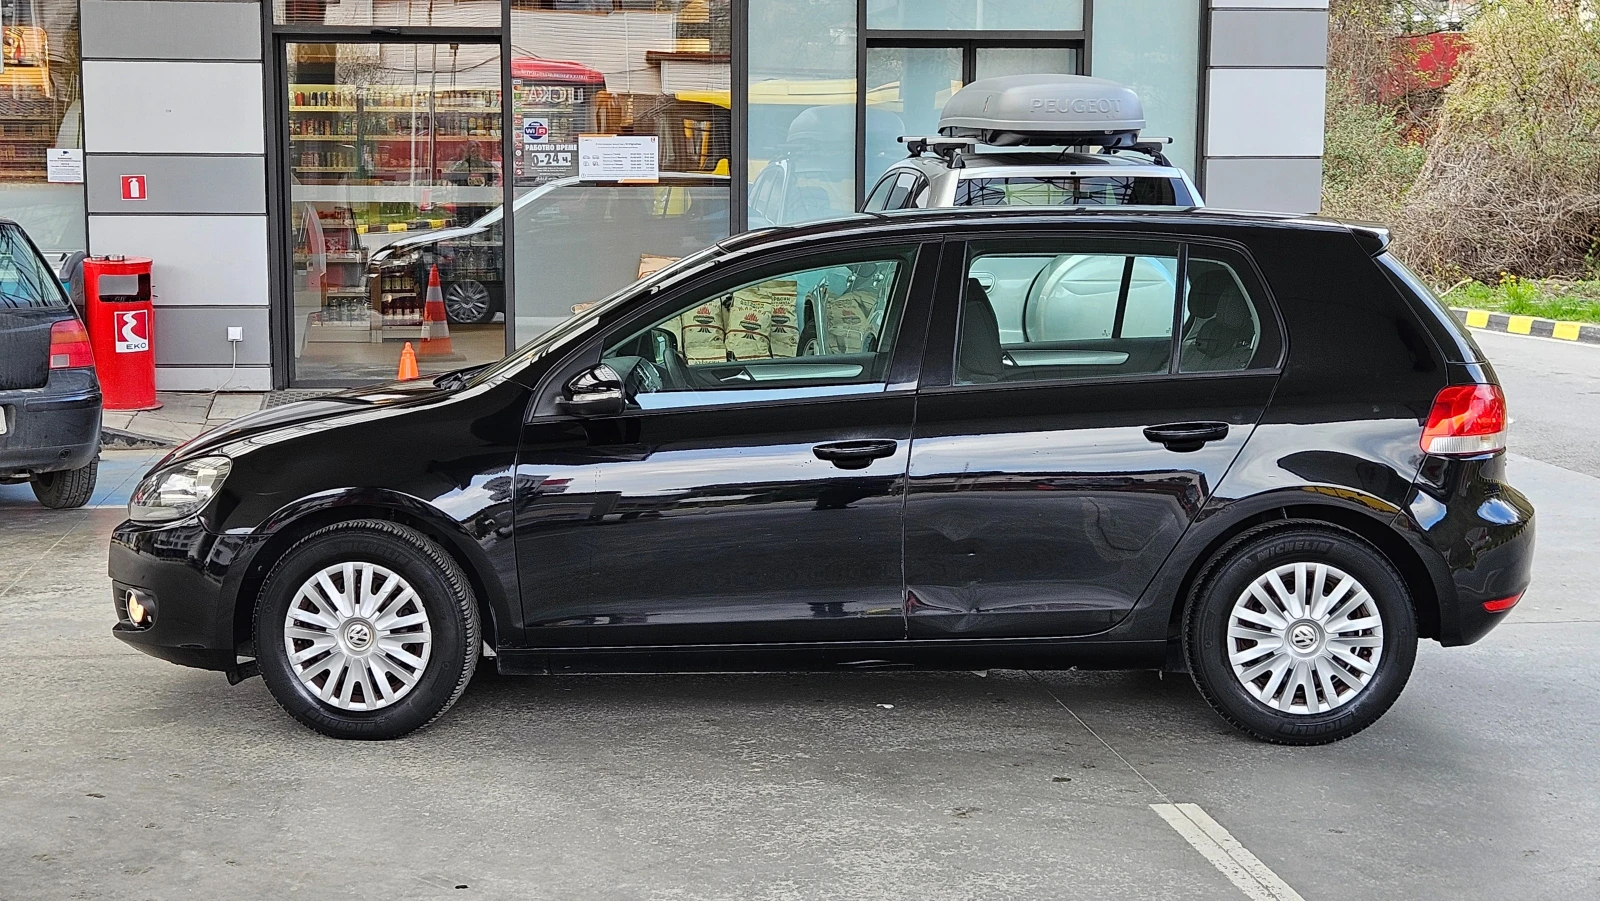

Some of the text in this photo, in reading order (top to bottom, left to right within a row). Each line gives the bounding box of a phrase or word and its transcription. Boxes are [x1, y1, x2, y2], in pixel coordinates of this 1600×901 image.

[1030, 98, 1122, 113] PEUGEOT
[532, 152, 560, 166] 0-24
[1257, 541, 1331, 562] MICHELIN
